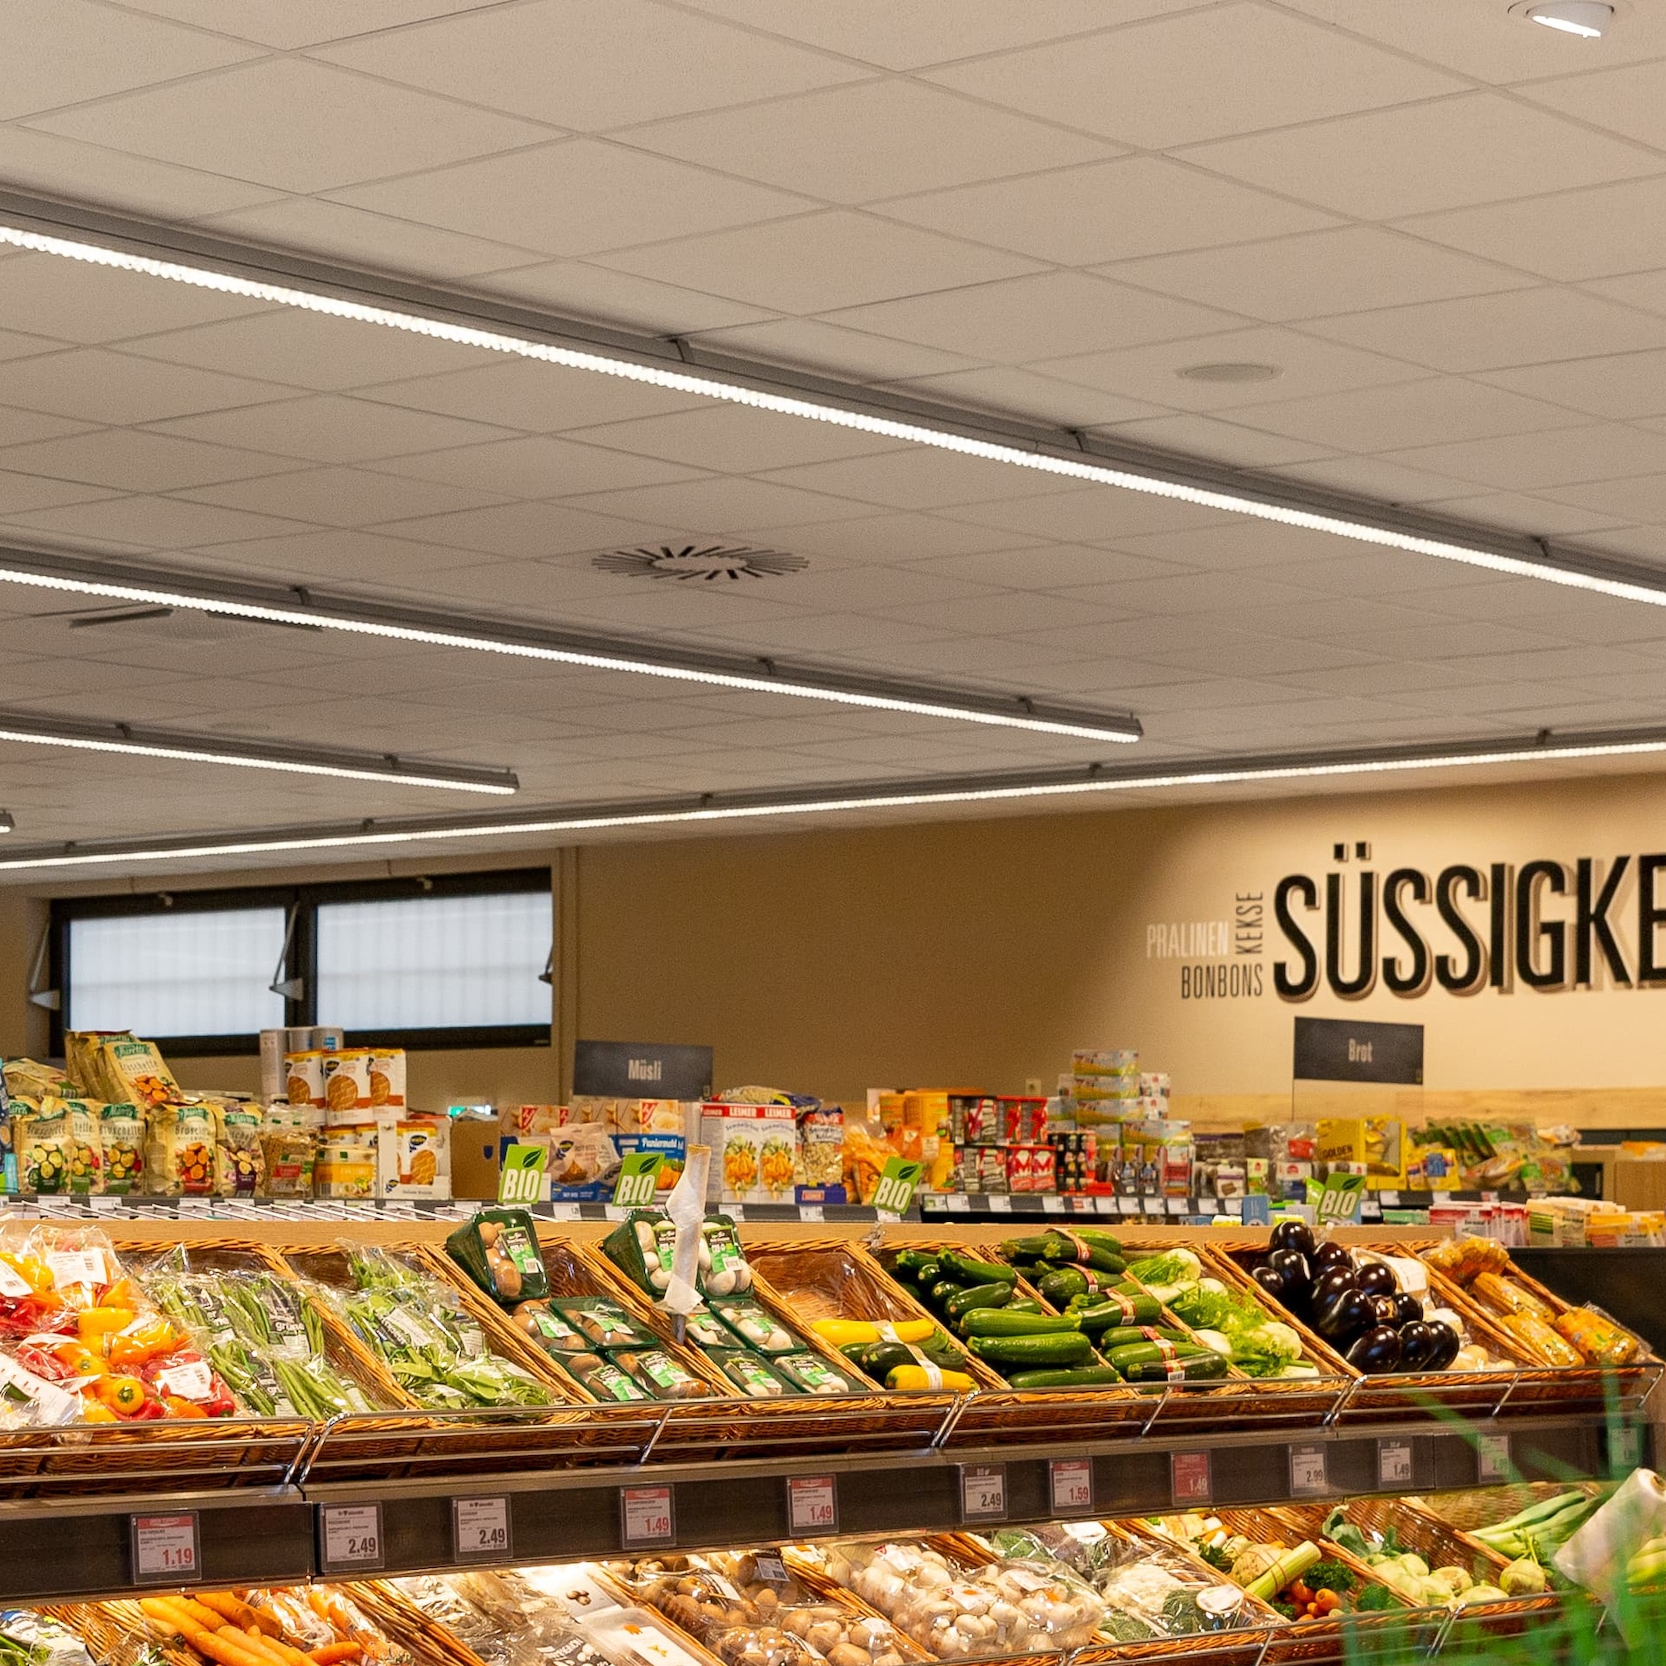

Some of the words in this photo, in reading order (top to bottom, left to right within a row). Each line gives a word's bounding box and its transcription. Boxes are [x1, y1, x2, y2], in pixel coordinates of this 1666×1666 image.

[1235, 891, 1264, 955] KEKSE
[1146, 920, 1230, 958] PRALINEN
[1180, 964, 1264, 999] BONBONS
[1347, 1038, 1373, 1063] Brot
[627, 1058, 662, 1081] Müsli
[729, 1106, 757, 1118] LEIMER
[764, 1107, 792, 1119] LEIMER
[502, 1169, 540, 1201] BIO
[616, 1174, 656, 1206] BIO
[874, 1177, 912, 1210] BIO
[1319, 1190, 1357, 1216] BIO
[1306, 1469, 1324, 1483] 2.99
[1393, 1464, 1410, 1477] 1.49
[1068, 1486, 1089, 1501] 1.59
[1188, 1477, 1208, 1492] 1.49
[980, 1492, 1002, 1508] 2.49
[809, 1504, 832, 1521] 1.49
[644, 1516, 669, 1533] 1.49
[348, 1536, 376, 1556] 2.49
[478, 1527, 506, 1546] 2.49
[162, 1547, 193, 1567] 1.19
